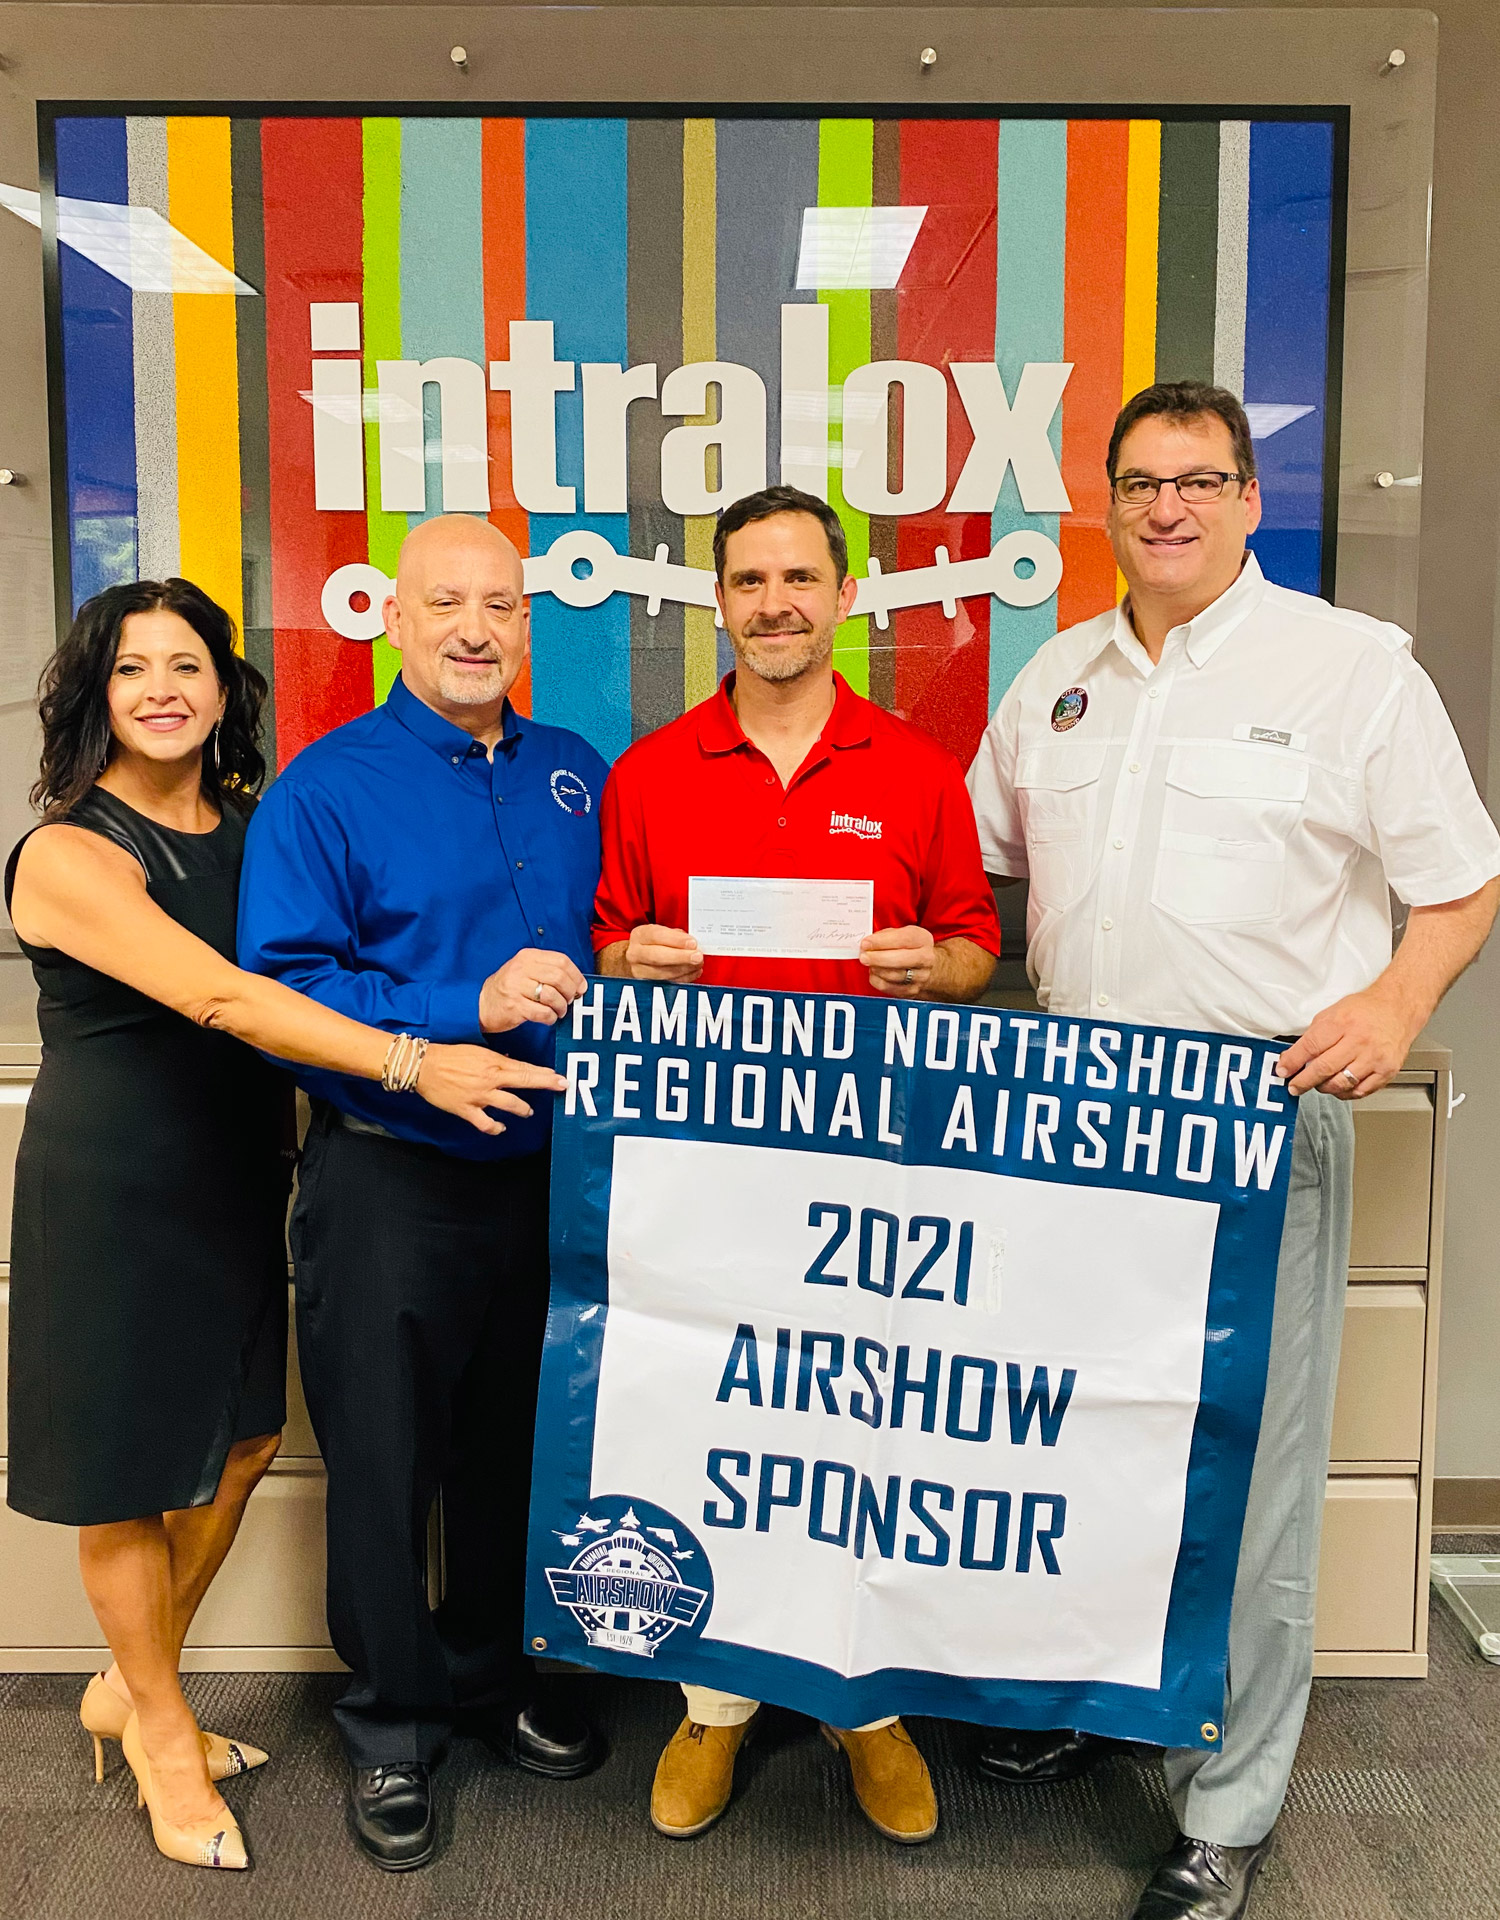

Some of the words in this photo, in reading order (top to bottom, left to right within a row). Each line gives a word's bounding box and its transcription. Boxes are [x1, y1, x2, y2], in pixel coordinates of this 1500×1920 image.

[310, 302, 1074, 516] intralox
[1061, 689, 1076, 699] CITY
[830, 810, 882, 833] intralox
[571, 983, 856, 1060] HAMMOND
[883, 1005, 1285, 1113] NORTHSHORE
[564, 1052, 903, 1146] REGIONAL
[941, 1085, 1287, 1191] AIRSHOW
[803, 1201, 974, 1307] 2021
[715, 1323, 1078, 1447] AIRSHOW
[702, 1447, 1068, 1576] SPONSOR
[579, 1545, 609, 1570] HAMMOND
[606, 1568, 645, 1577] REGIONAL
[576, 1574, 677, 1615] AIRSHOW
[620, 1634, 633, 1645] 1979
